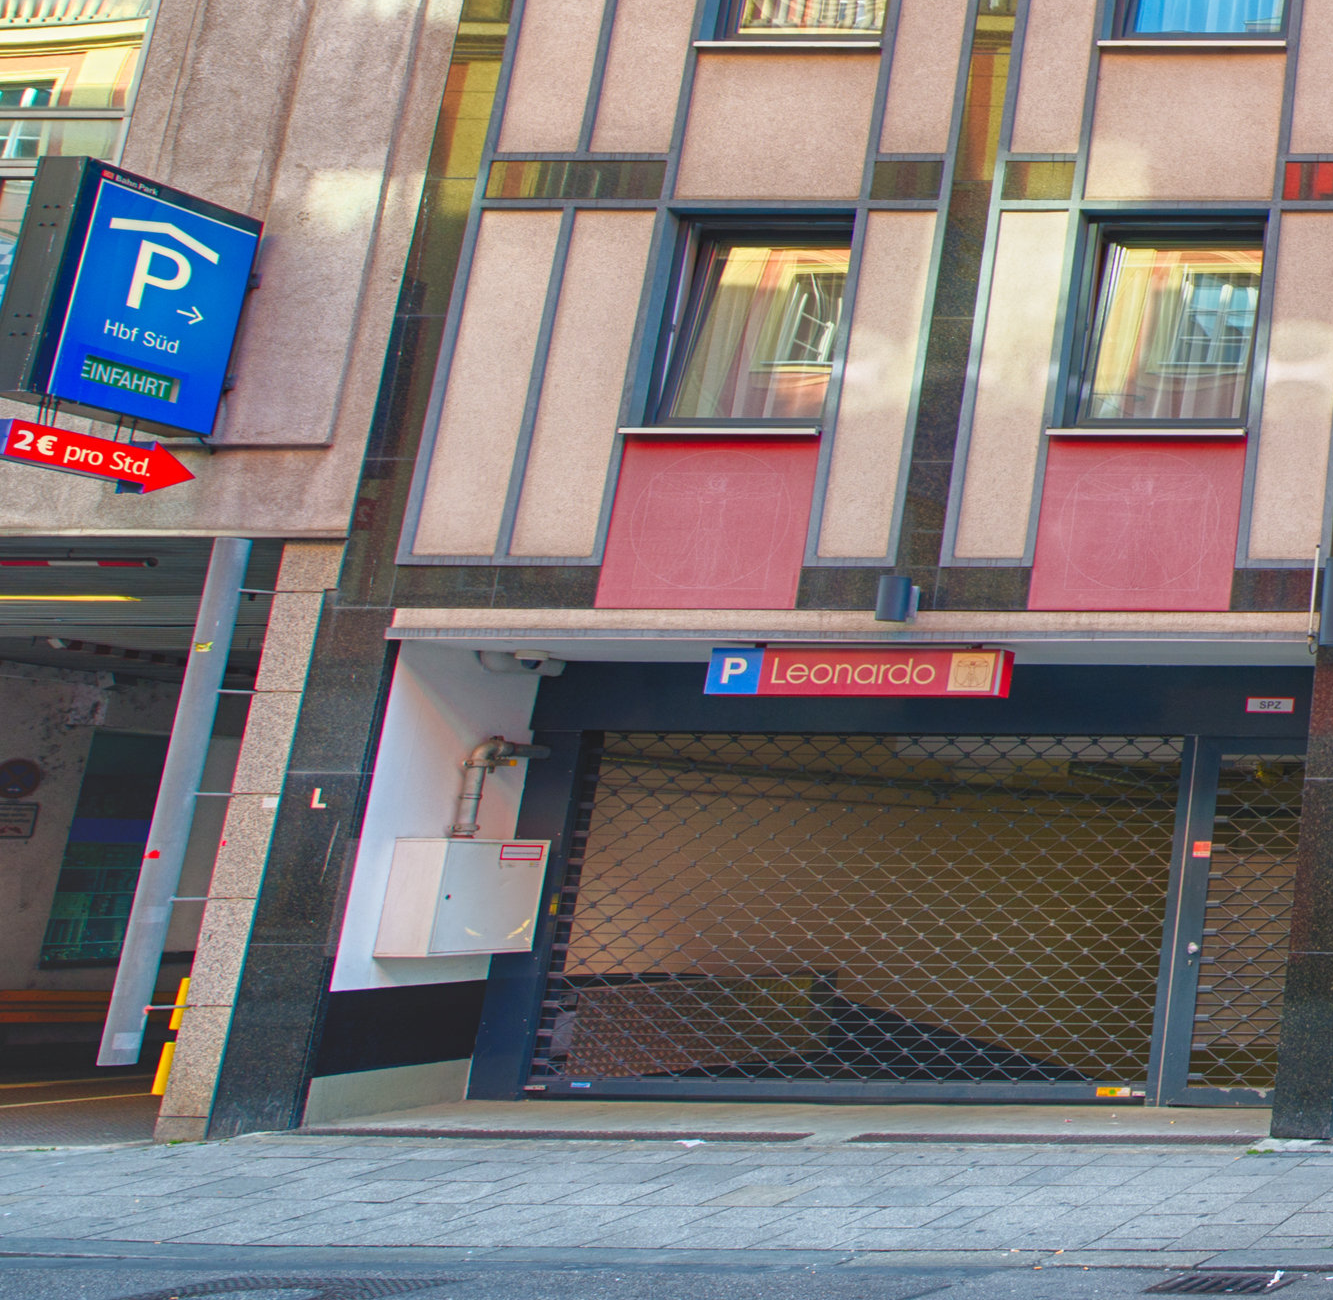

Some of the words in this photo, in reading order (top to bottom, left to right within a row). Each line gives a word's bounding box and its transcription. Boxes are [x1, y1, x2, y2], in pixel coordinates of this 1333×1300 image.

[114, 174, 138, 189] Bahn
[138, 183, 159, 197] Park
[126, 240, 193, 310] P
[103, 319, 139, 343] Hbf
[143, 329, 180, 354] Süd
[81, 358, 171, 398] EINFAHRT
[63, 445, 104, 466] pro
[109, 451, 151, 477] Std.
[719, 657, 748, 685] P
[769, 657, 936, 686] Leonardo
[1259, 700, 1282, 710] SPZ
